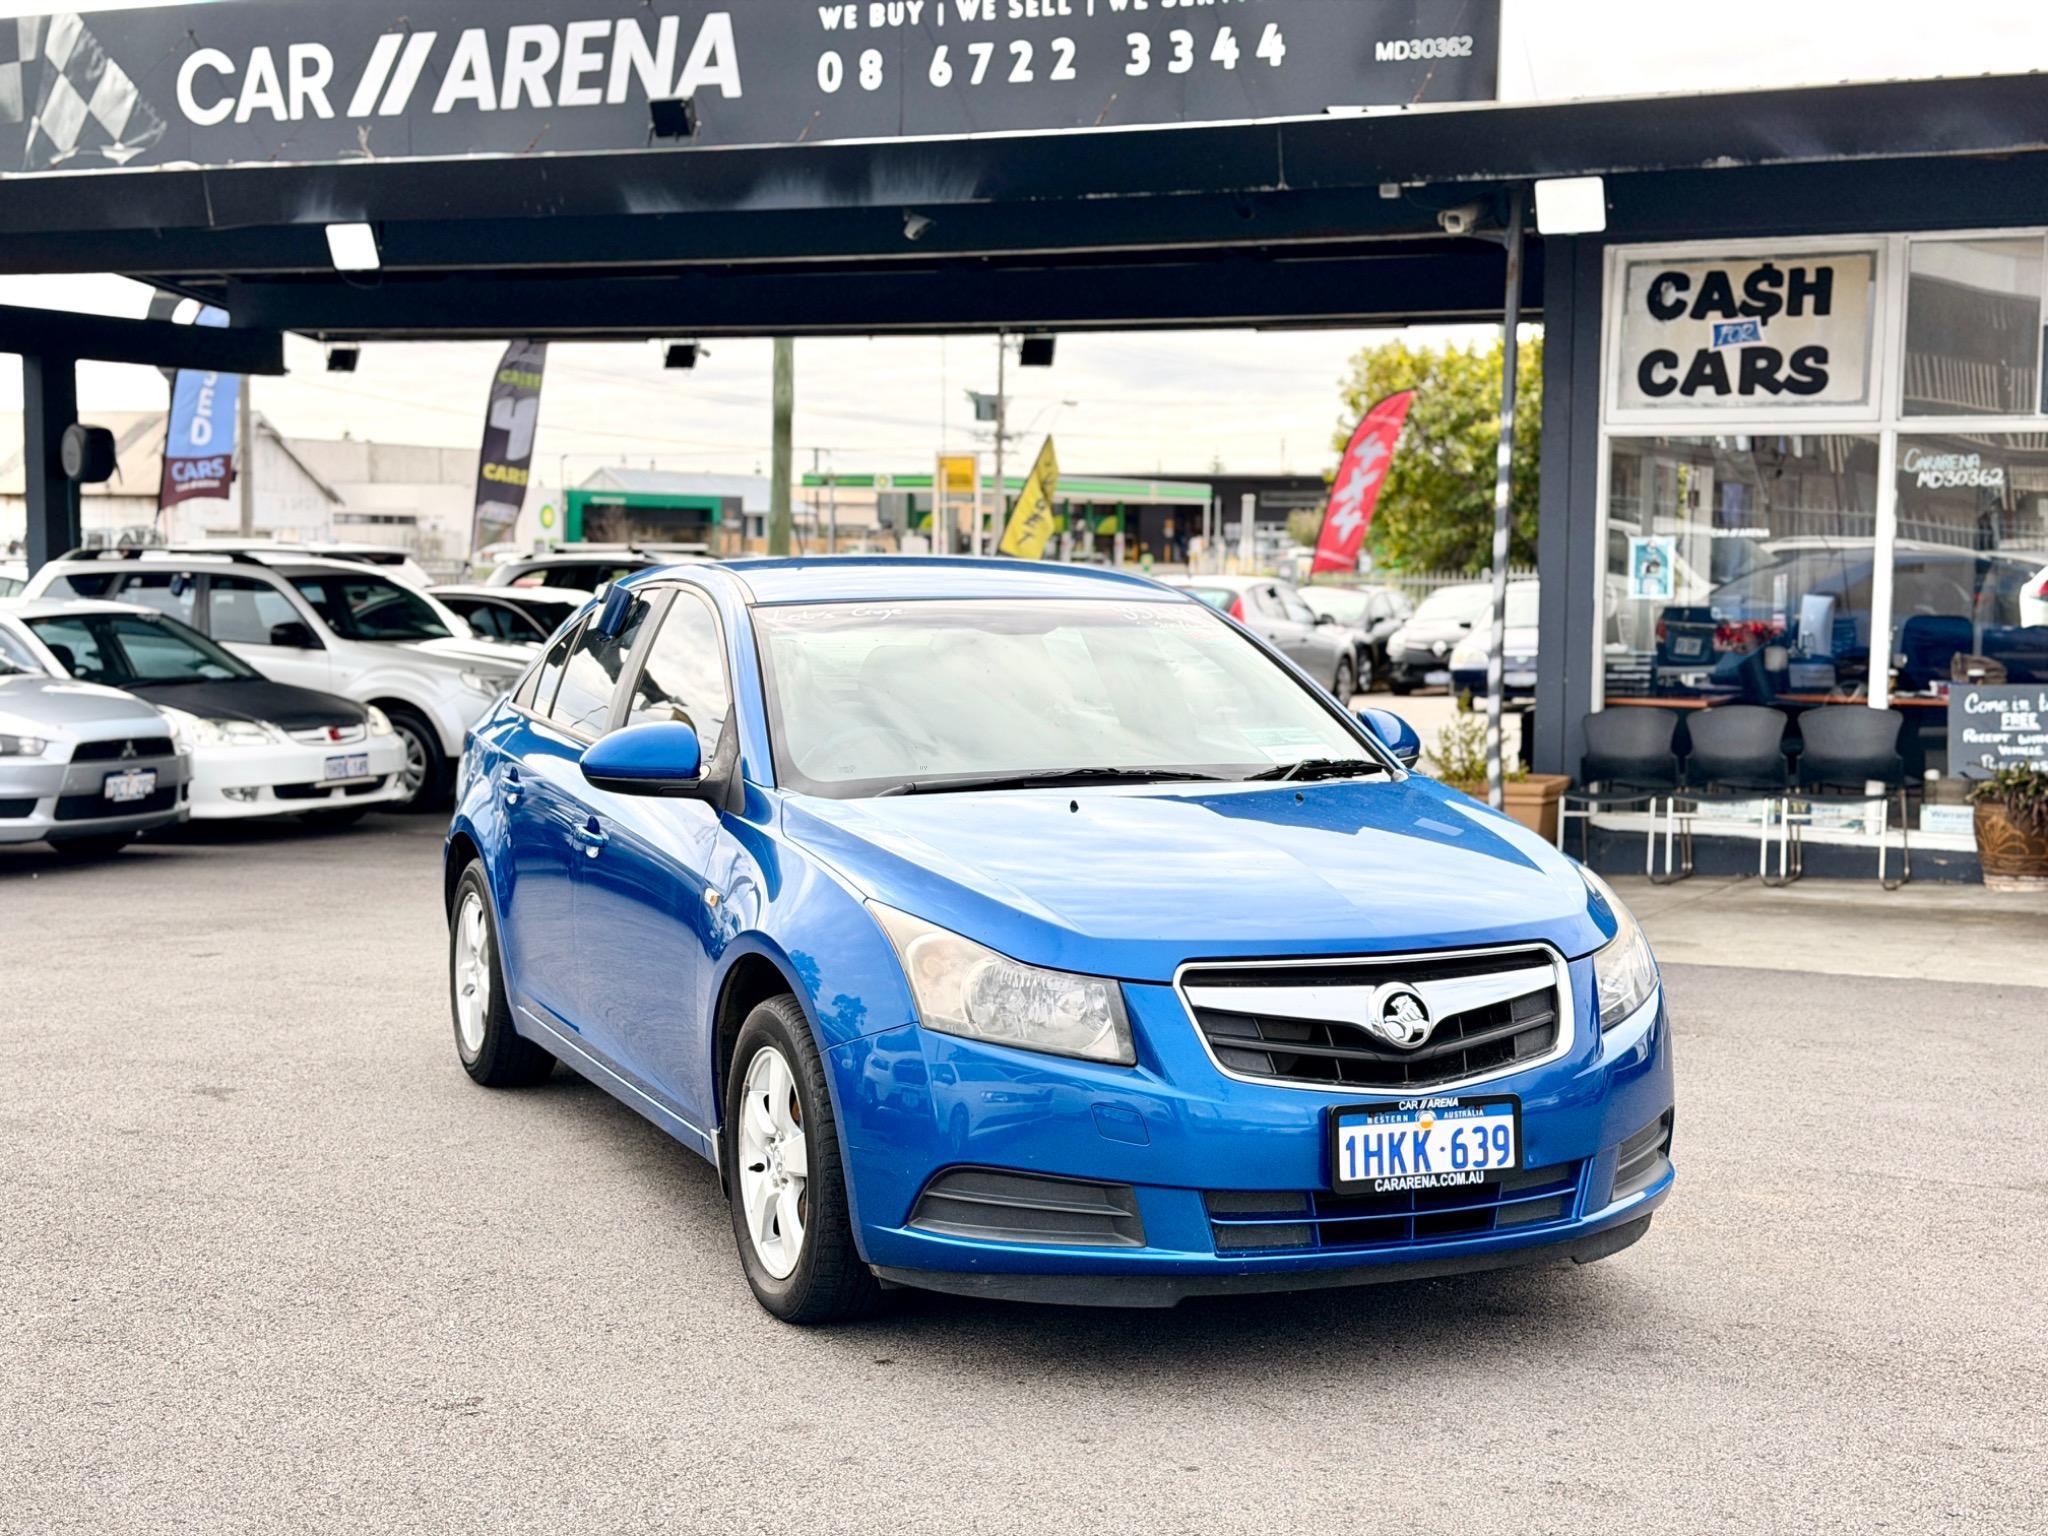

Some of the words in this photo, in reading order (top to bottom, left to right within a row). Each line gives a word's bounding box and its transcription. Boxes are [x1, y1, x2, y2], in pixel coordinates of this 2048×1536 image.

[818, 6, 858, 31] WE
[869, 1, 924, 28] BUY
[955, 0, 996, 22] WE
[1008, 0, 1072, 19] SELL
[817, 48, 883, 93] 08
[929, 37, 1076, 88] 6722
[1125, 23, 1286, 76] 3344
[1375, 35, 1473, 61] MD30362
[176, 43, 335, 126] CAR
[432, 12, 743, 113] ARENA
[1716, 322, 1759, 346] FOR
[1637, 345, 1829, 397] CARS
[490, 396, 537, 462] 4
[171, 457, 226, 482] CARS
[1917, 468, 2005, 488] MD30362
[1367, 1114, 1409, 1124] WESTERN
[1443, 1108, 1485, 1119] AUSTRALIA
[1398, 1101, 1419, 1111] CAR
[1427, 1097, 1460, 1109] ARENA
[1374, 1170, 1486, 1193] CARARENA.COM.AU
